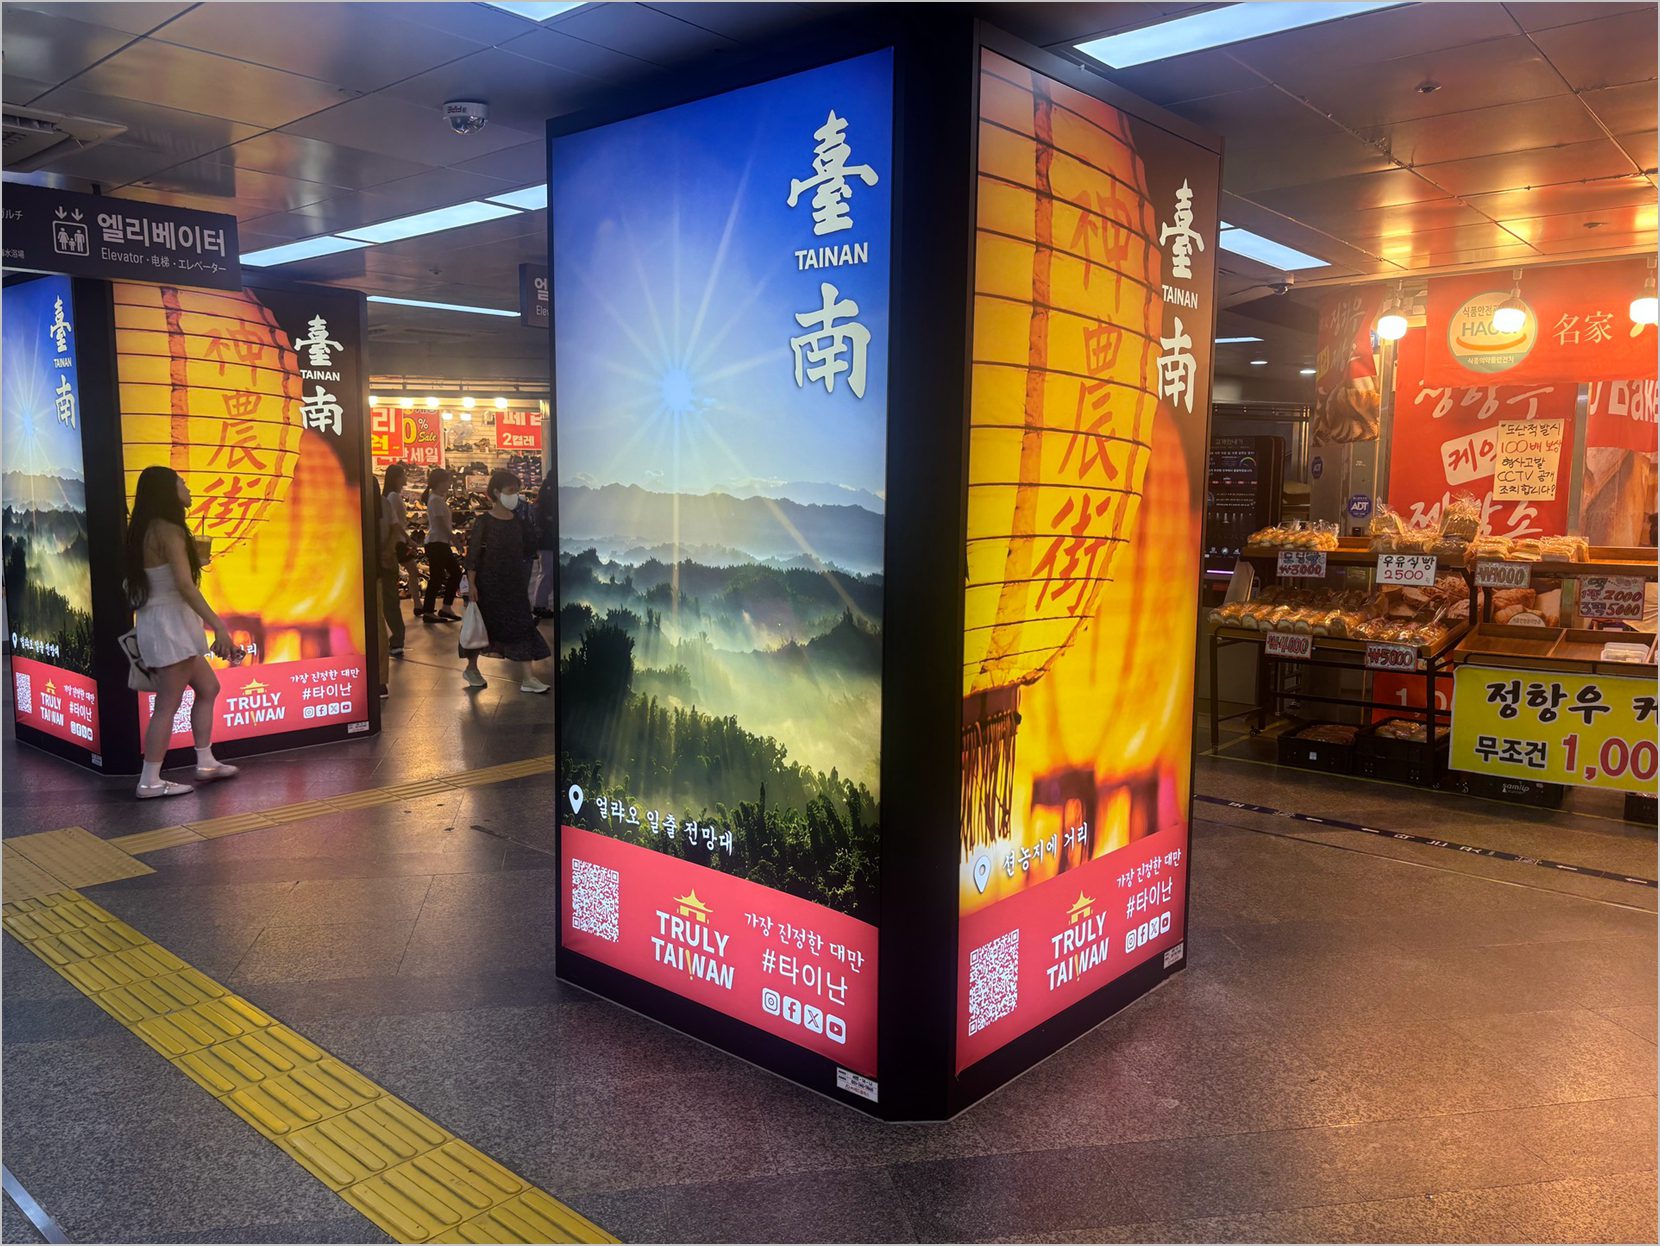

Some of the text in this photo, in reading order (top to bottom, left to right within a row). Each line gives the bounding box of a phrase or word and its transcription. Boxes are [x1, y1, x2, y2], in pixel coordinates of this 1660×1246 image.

[786, 109, 879, 236] 臺
[97, 213, 226, 257] 엘리베이터
[101, 247, 144, 264] Elevator
[794, 242, 868, 271] TAINAN
[1162, 284, 1199, 310] TAINAN
[790, 282, 871, 399] 南
[1552, 310, 1614, 346] 名家
[300, 370, 341, 382] TAINAN
[1156, 316, 1197, 414] 南
[299, 385, 343, 436] 南
[1497, 470, 1534, 482] CCTV
[1351, 501, 1369, 511] ADT
[1383, 555, 1435, 570] 우유식빵
[1384, 569, 1424, 581] 2500
[40, 692, 62, 711] TRULY
[226, 692, 281, 712] TRULY
[302, 682, 352, 701] #타이난
[1486, 680, 1611, 725] 정항우
[223, 706, 286, 727] TAIWAN
[1475, 736, 1547, 769] 무조건
[646, 810, 679, 839] 일출
[683, 821, 734, 856] 전망대
[1063, 821, 1089, 850] 거리
[1116, 848, 1182, 888] 가장 진정한 대만
[1126, 877, 1174, 920] #타이난
[656, 909, 731, 957] TRULY
[744, 911, 866, 973] 가장 진정한 대만
[1051, 911, 1108, 960] TRULY
[651, 936, 736, 991] TAIWAN
[762, 948, 848, 1006] #타이난
[1046, 937, 1110, 992] TAIWAN
